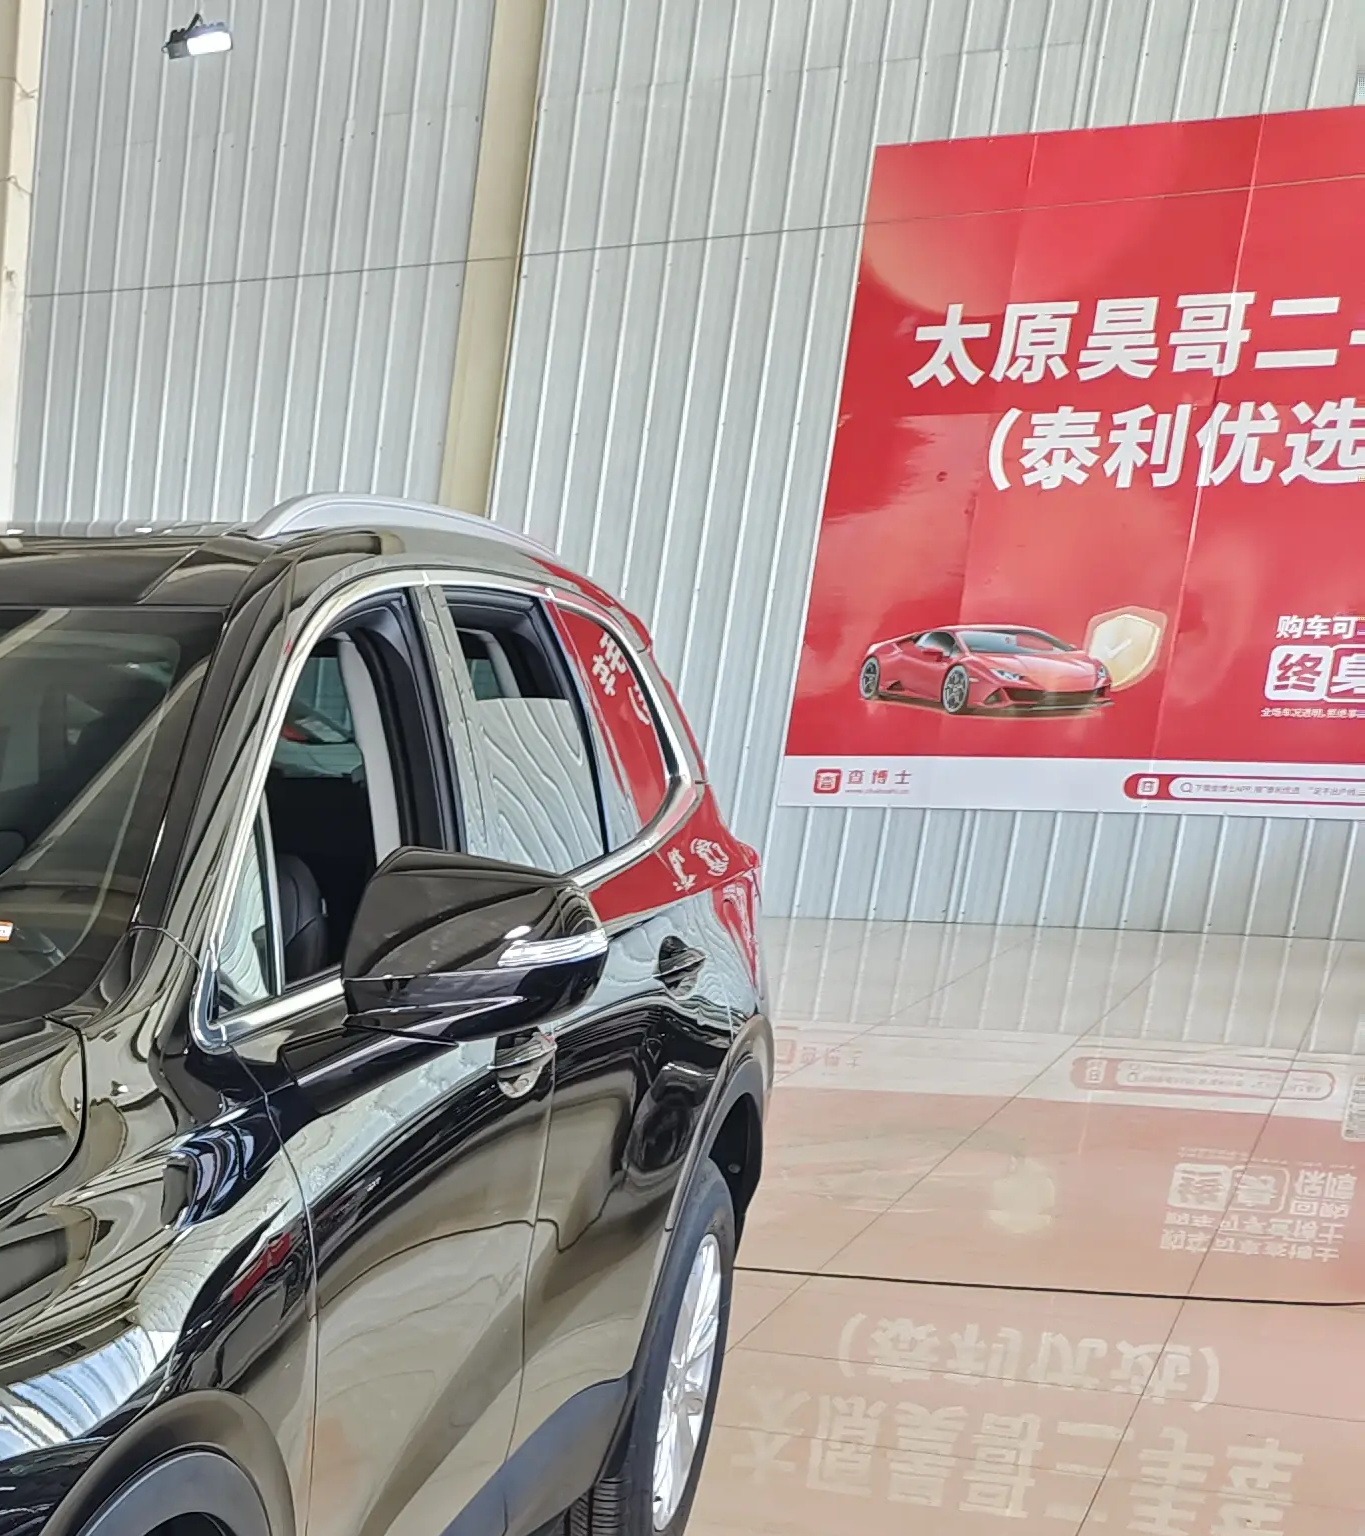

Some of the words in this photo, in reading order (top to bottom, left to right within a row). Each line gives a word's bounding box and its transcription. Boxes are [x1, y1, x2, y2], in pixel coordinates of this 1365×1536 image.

[907, 291, 1365, 389] 太原昊哥二
[1275, 614, 1365, 640] 购车可
[846, 768, 913, 786] 查博士
